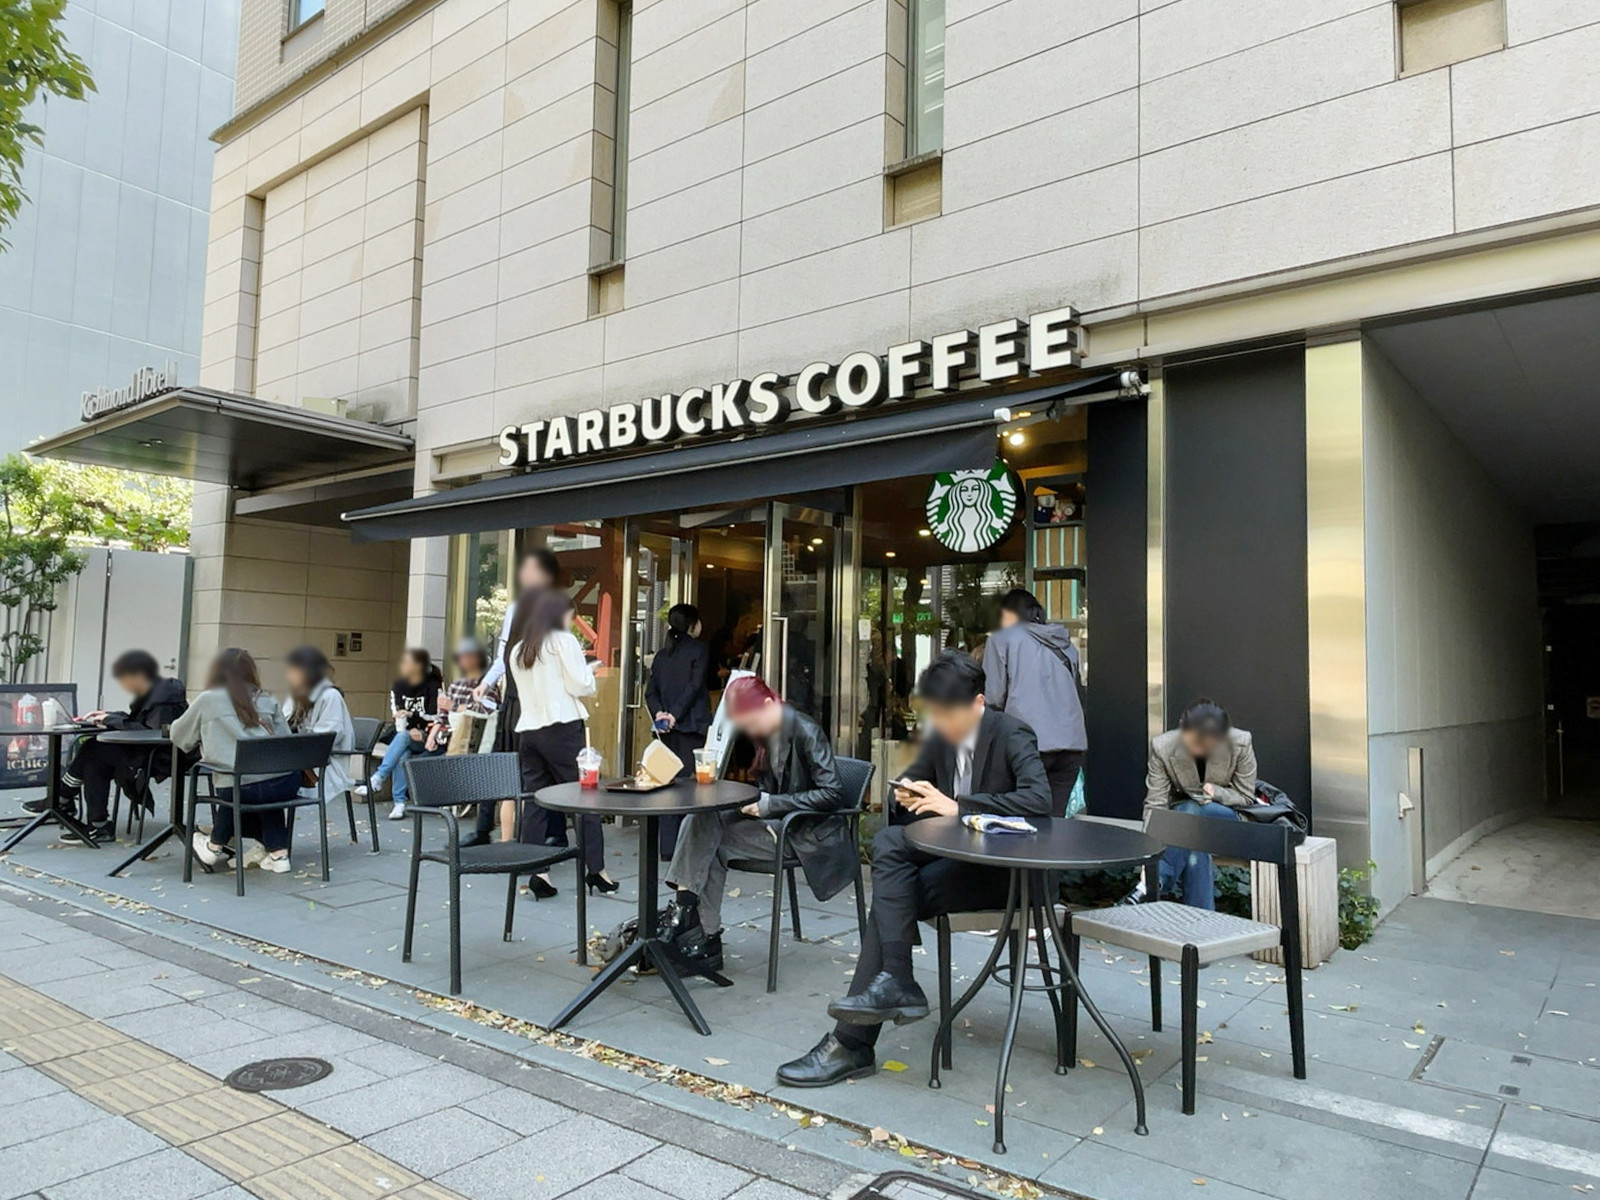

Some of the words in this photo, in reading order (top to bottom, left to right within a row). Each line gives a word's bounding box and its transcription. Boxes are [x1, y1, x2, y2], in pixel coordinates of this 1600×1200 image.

[81, 373, 135, 420] Richmond
[135, 358, 171, 402] Hotel
[499, 372, 780, 467] STARBUCKS
[796, 306, 1072, 414] COFFEE
